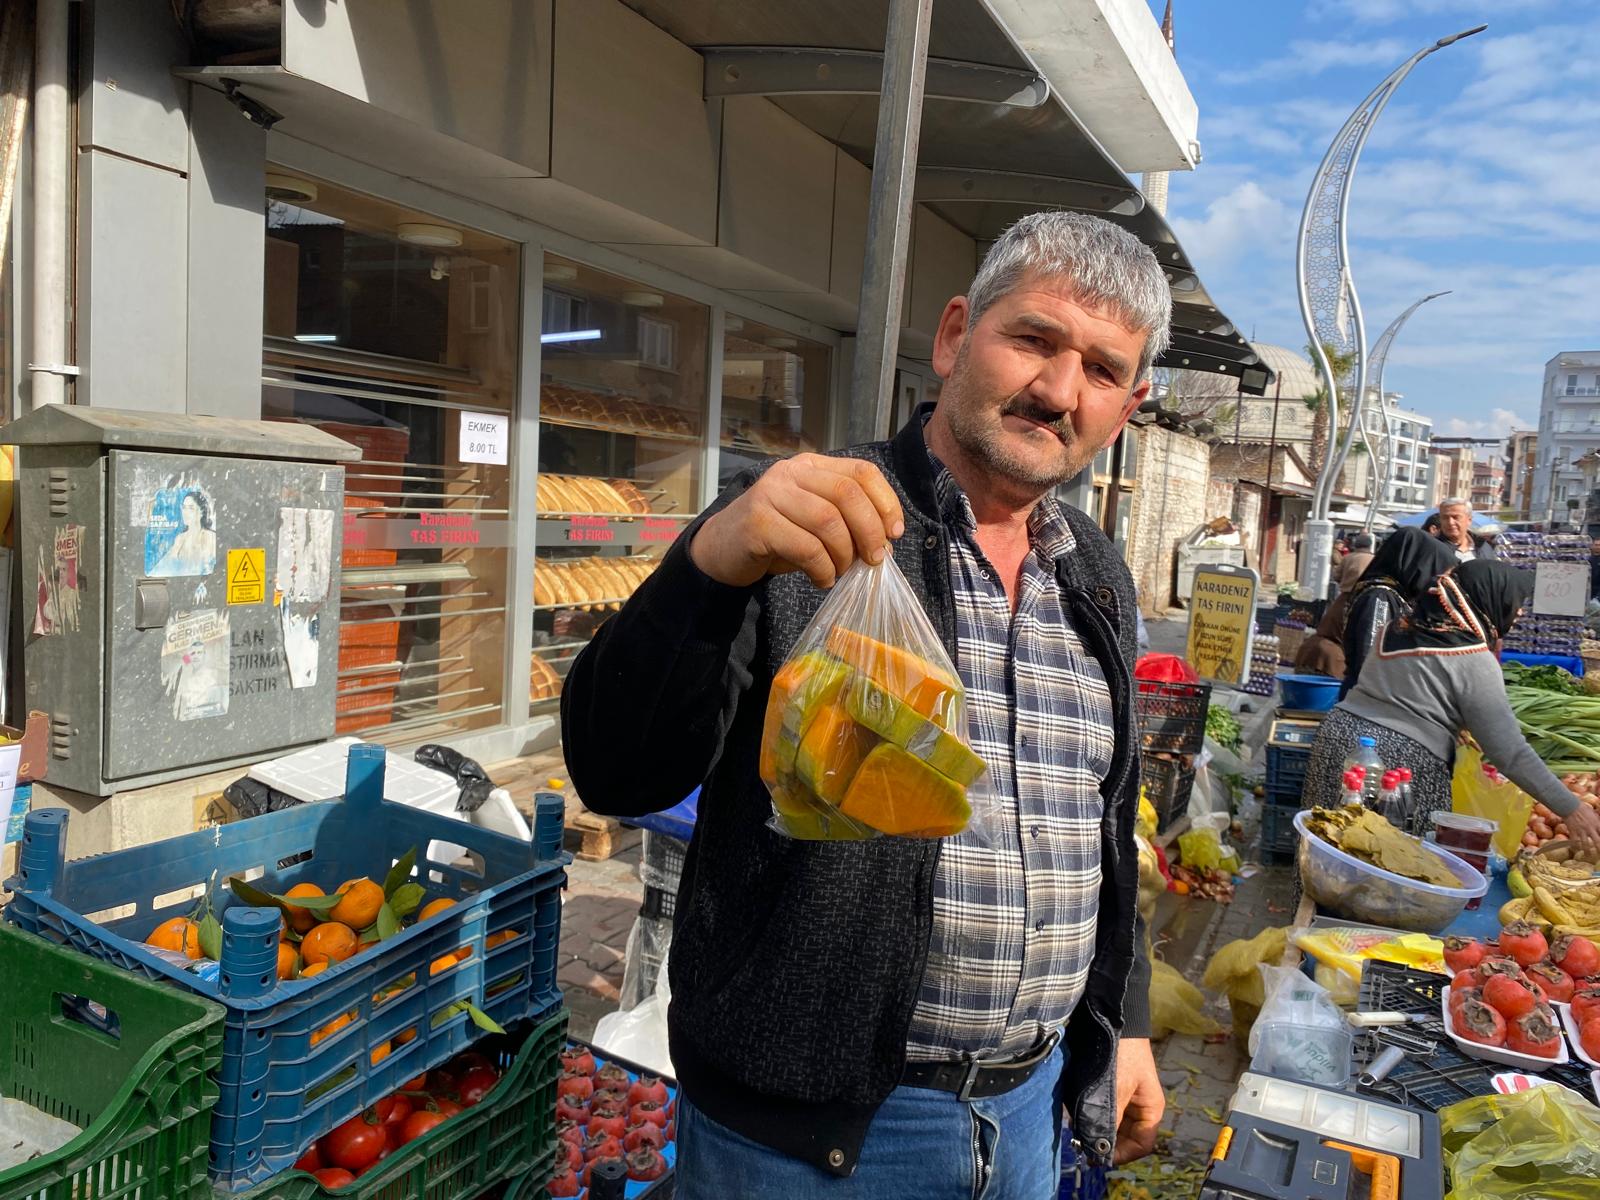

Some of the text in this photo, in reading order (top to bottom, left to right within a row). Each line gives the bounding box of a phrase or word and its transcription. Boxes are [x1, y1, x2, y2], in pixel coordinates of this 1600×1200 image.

[467, 421, 497, 433] EKMEK
[470, 442, 497, 454] 8.00 TL
[411, 530, 437, 544] TAŞ
[1197, 581, 1250, 598] KARADENİZ
[1198, 598, 1245, 615] TAŞ FIRINI
